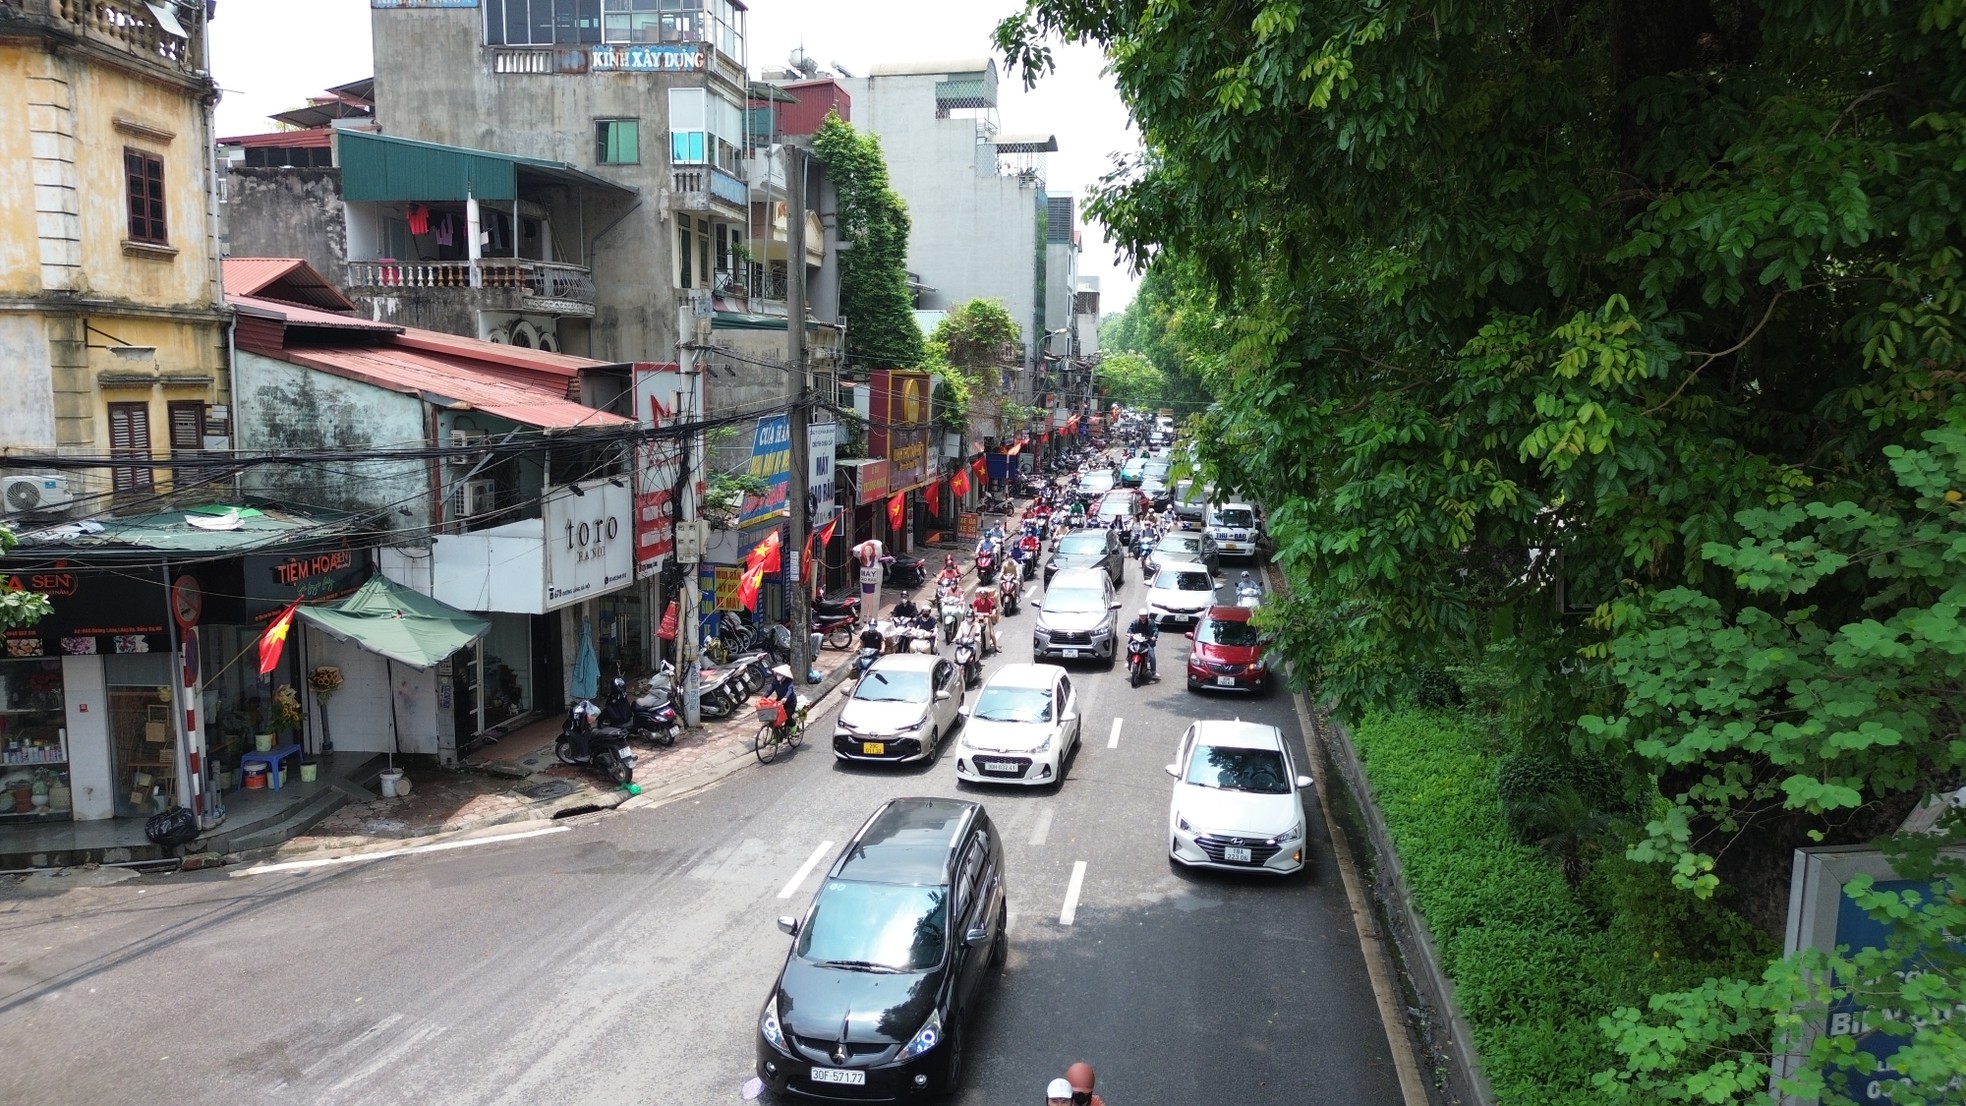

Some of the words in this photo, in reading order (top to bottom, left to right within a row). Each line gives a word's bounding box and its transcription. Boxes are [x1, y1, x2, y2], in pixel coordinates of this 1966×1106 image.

[593, 48, 630, 67] KÍNH
[632, 49, 661, 67] XÂY
[664, 48, 704, 70] DỰNG
[775, 420, 790, 443] HÀN
[565, 516, 618, 550] toro
[32, 574, 70, 588] SEN
[278, 557, 309, 586] TIỆM
[312, 554, 338, 576] HOA
